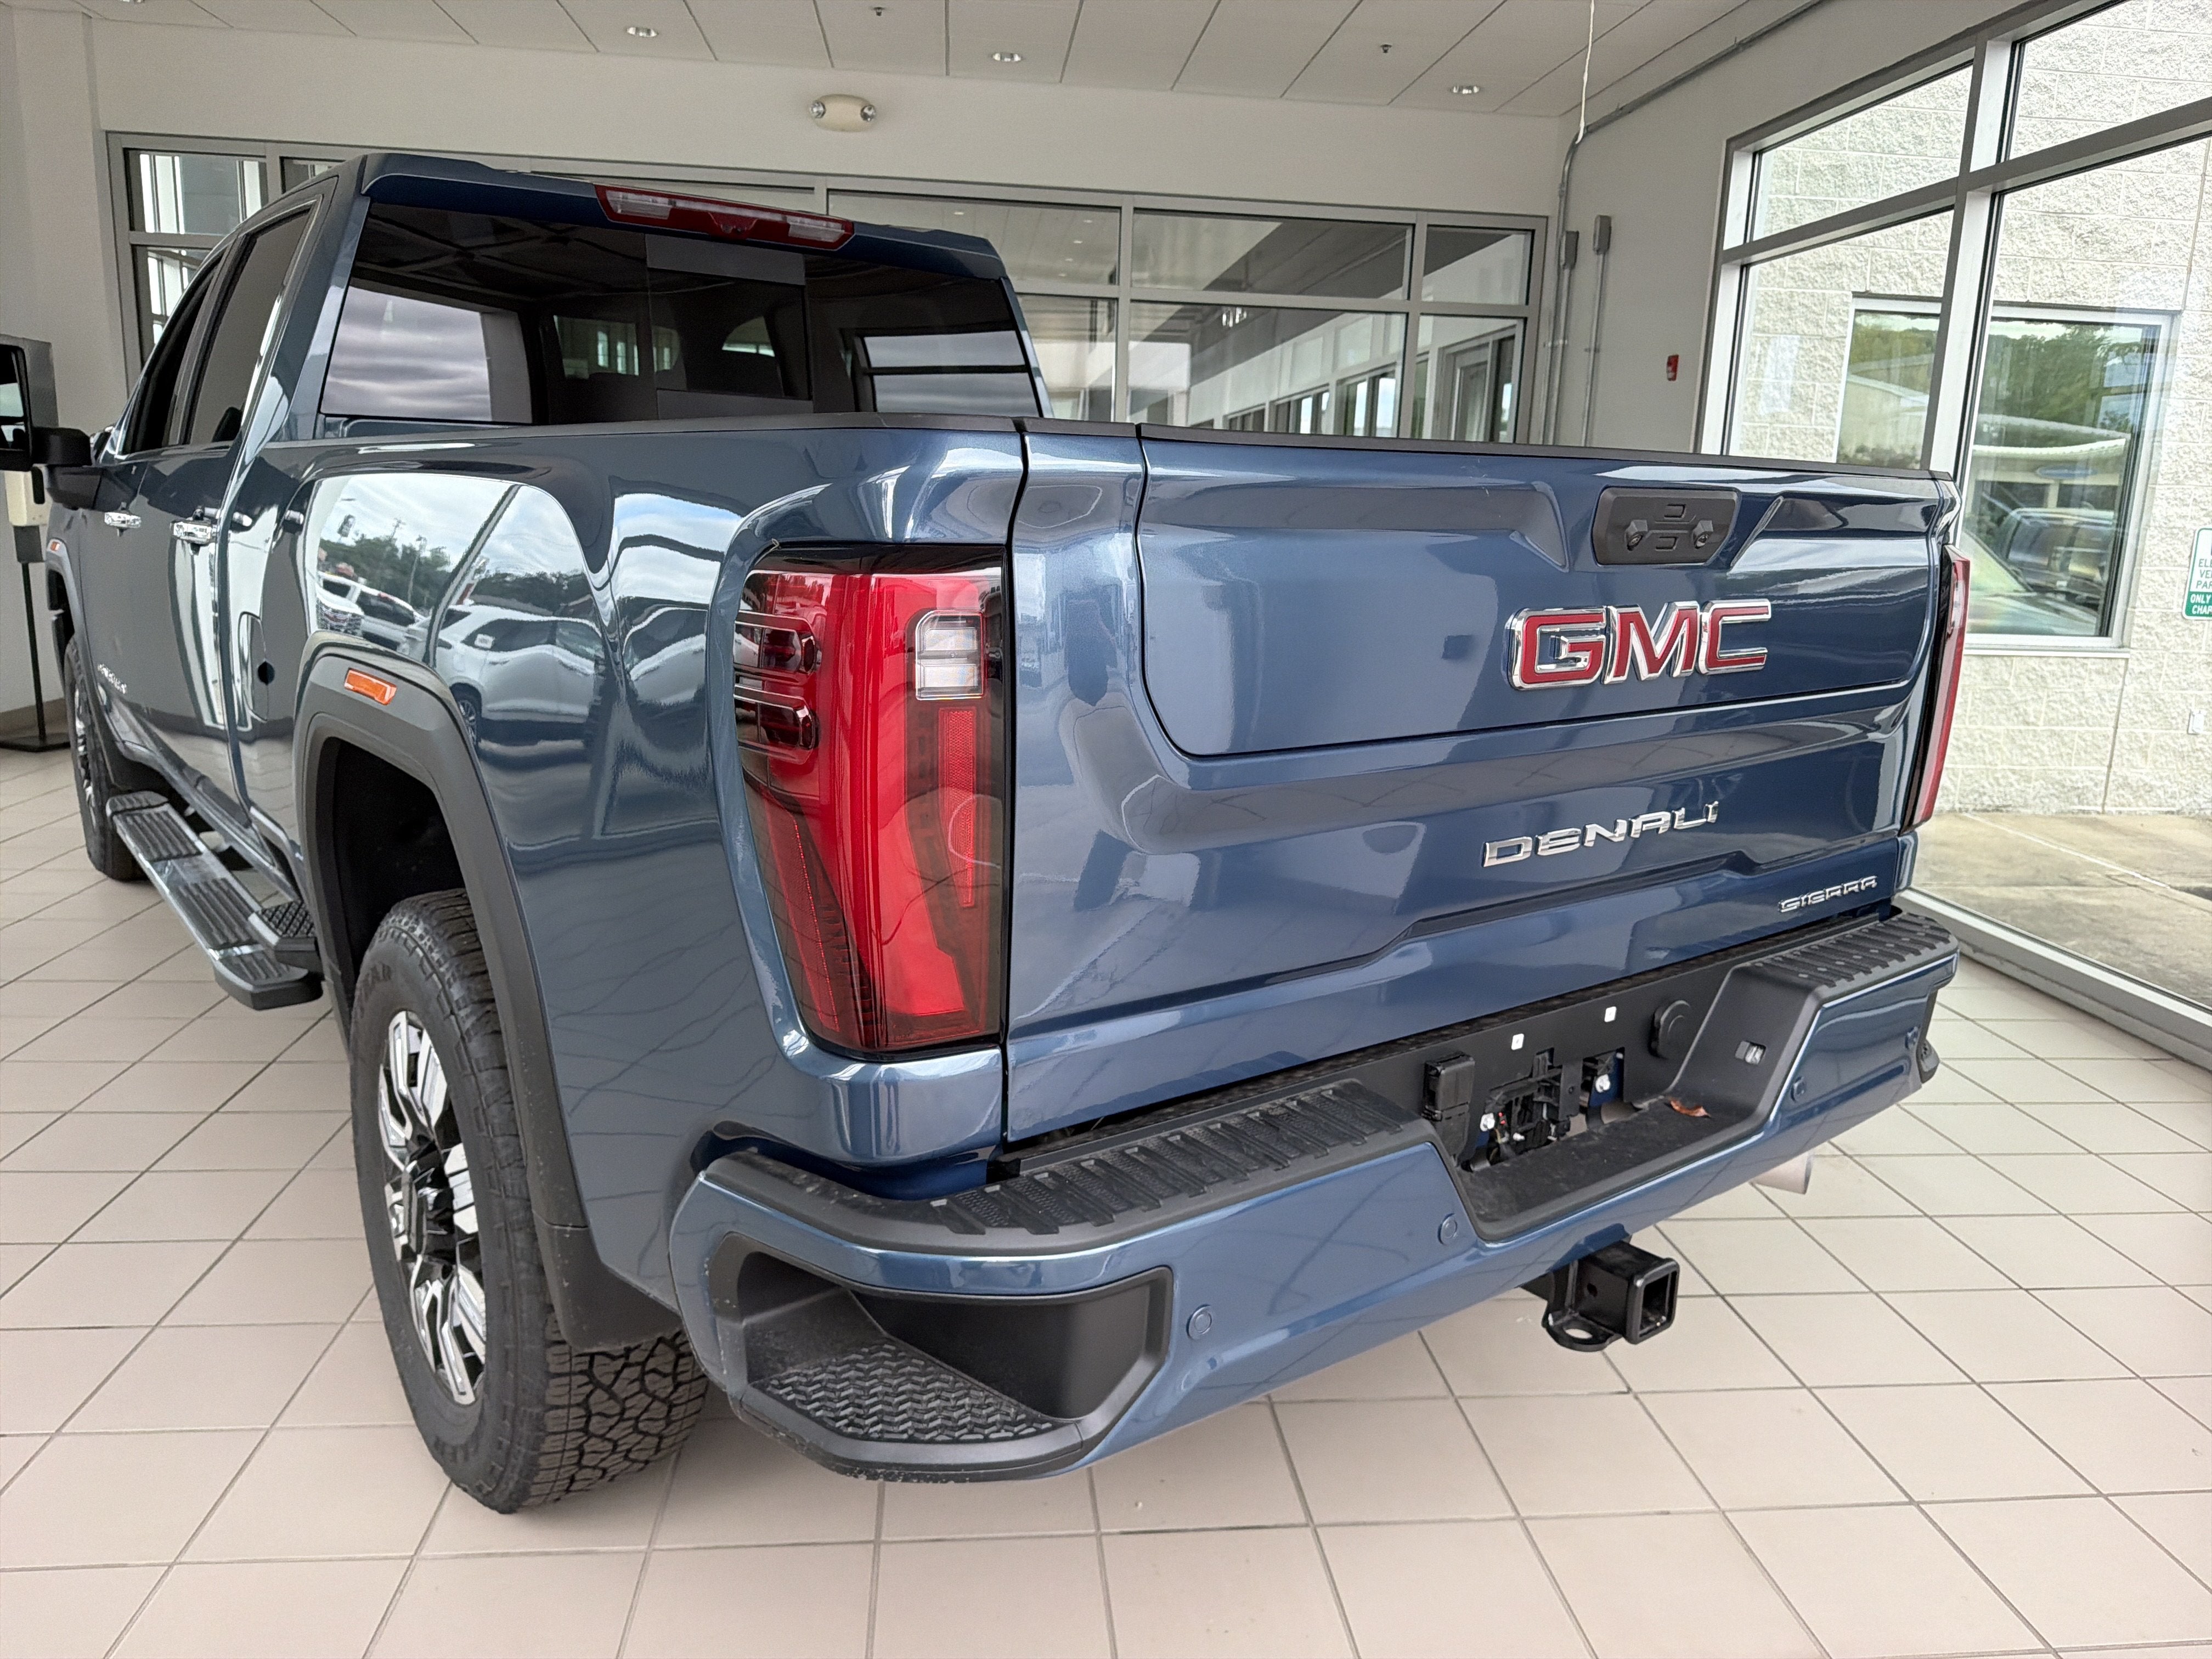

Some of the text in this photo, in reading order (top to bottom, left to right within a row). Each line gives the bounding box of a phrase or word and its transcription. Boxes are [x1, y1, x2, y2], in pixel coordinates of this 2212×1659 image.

[2199, 569, 2212, 579] VE
[2190, 594, 2211, 604] ONLY
[1505, 600, 1772, 690] GMC
[1482, 800, 1719, 867] DENALI
[1778, 875, 1878, 913] SIERRA
